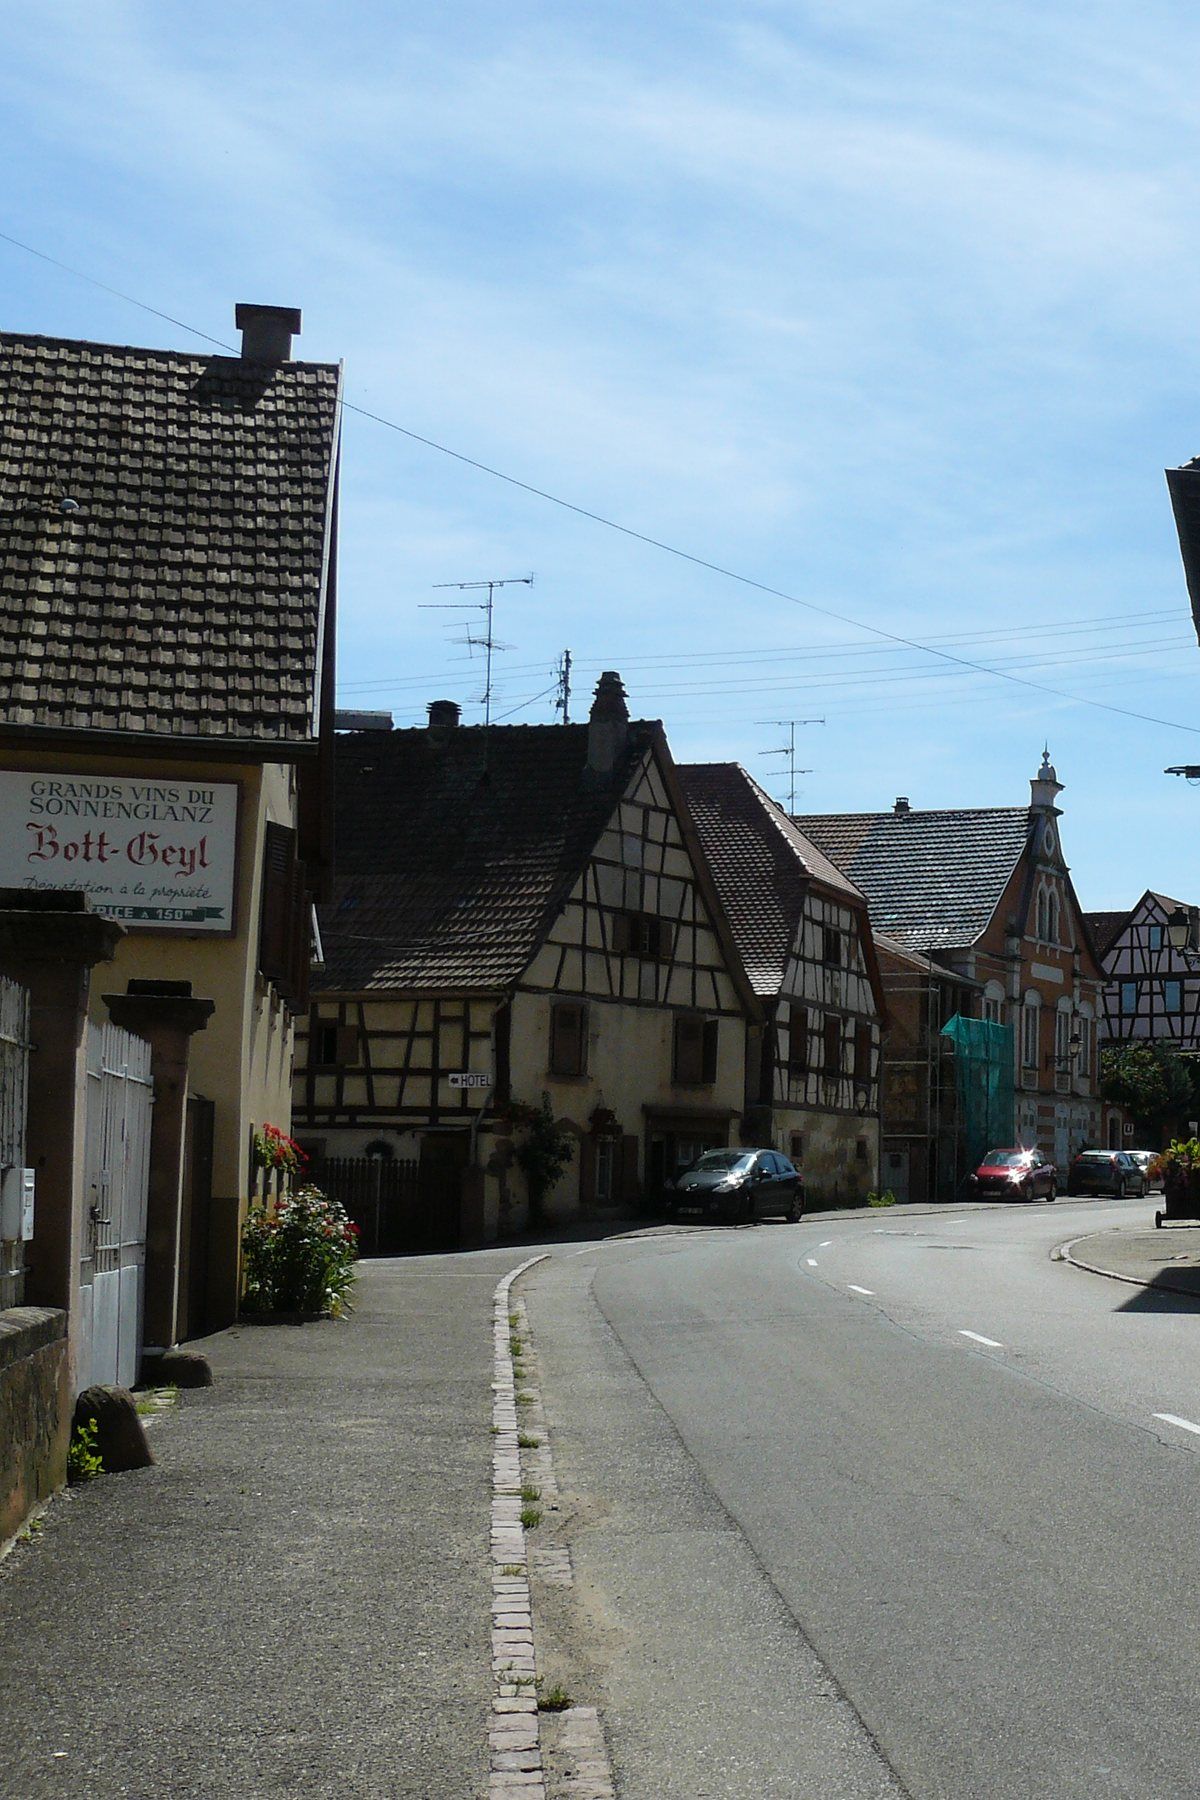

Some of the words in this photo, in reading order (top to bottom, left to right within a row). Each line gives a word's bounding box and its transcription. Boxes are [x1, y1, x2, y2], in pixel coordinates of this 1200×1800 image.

[31, 780, 123, 800] GRANDS
[130, 786, 181, 803] VINS
[188, 789, 215, 805] DU
[29, 797, 214, 824] SONNENGLANZ
[26, 821, 212, 879] Bott-Geyl
[133, 881, 146, 895] la
[461, 1074, 491, 1087] HOTEL
